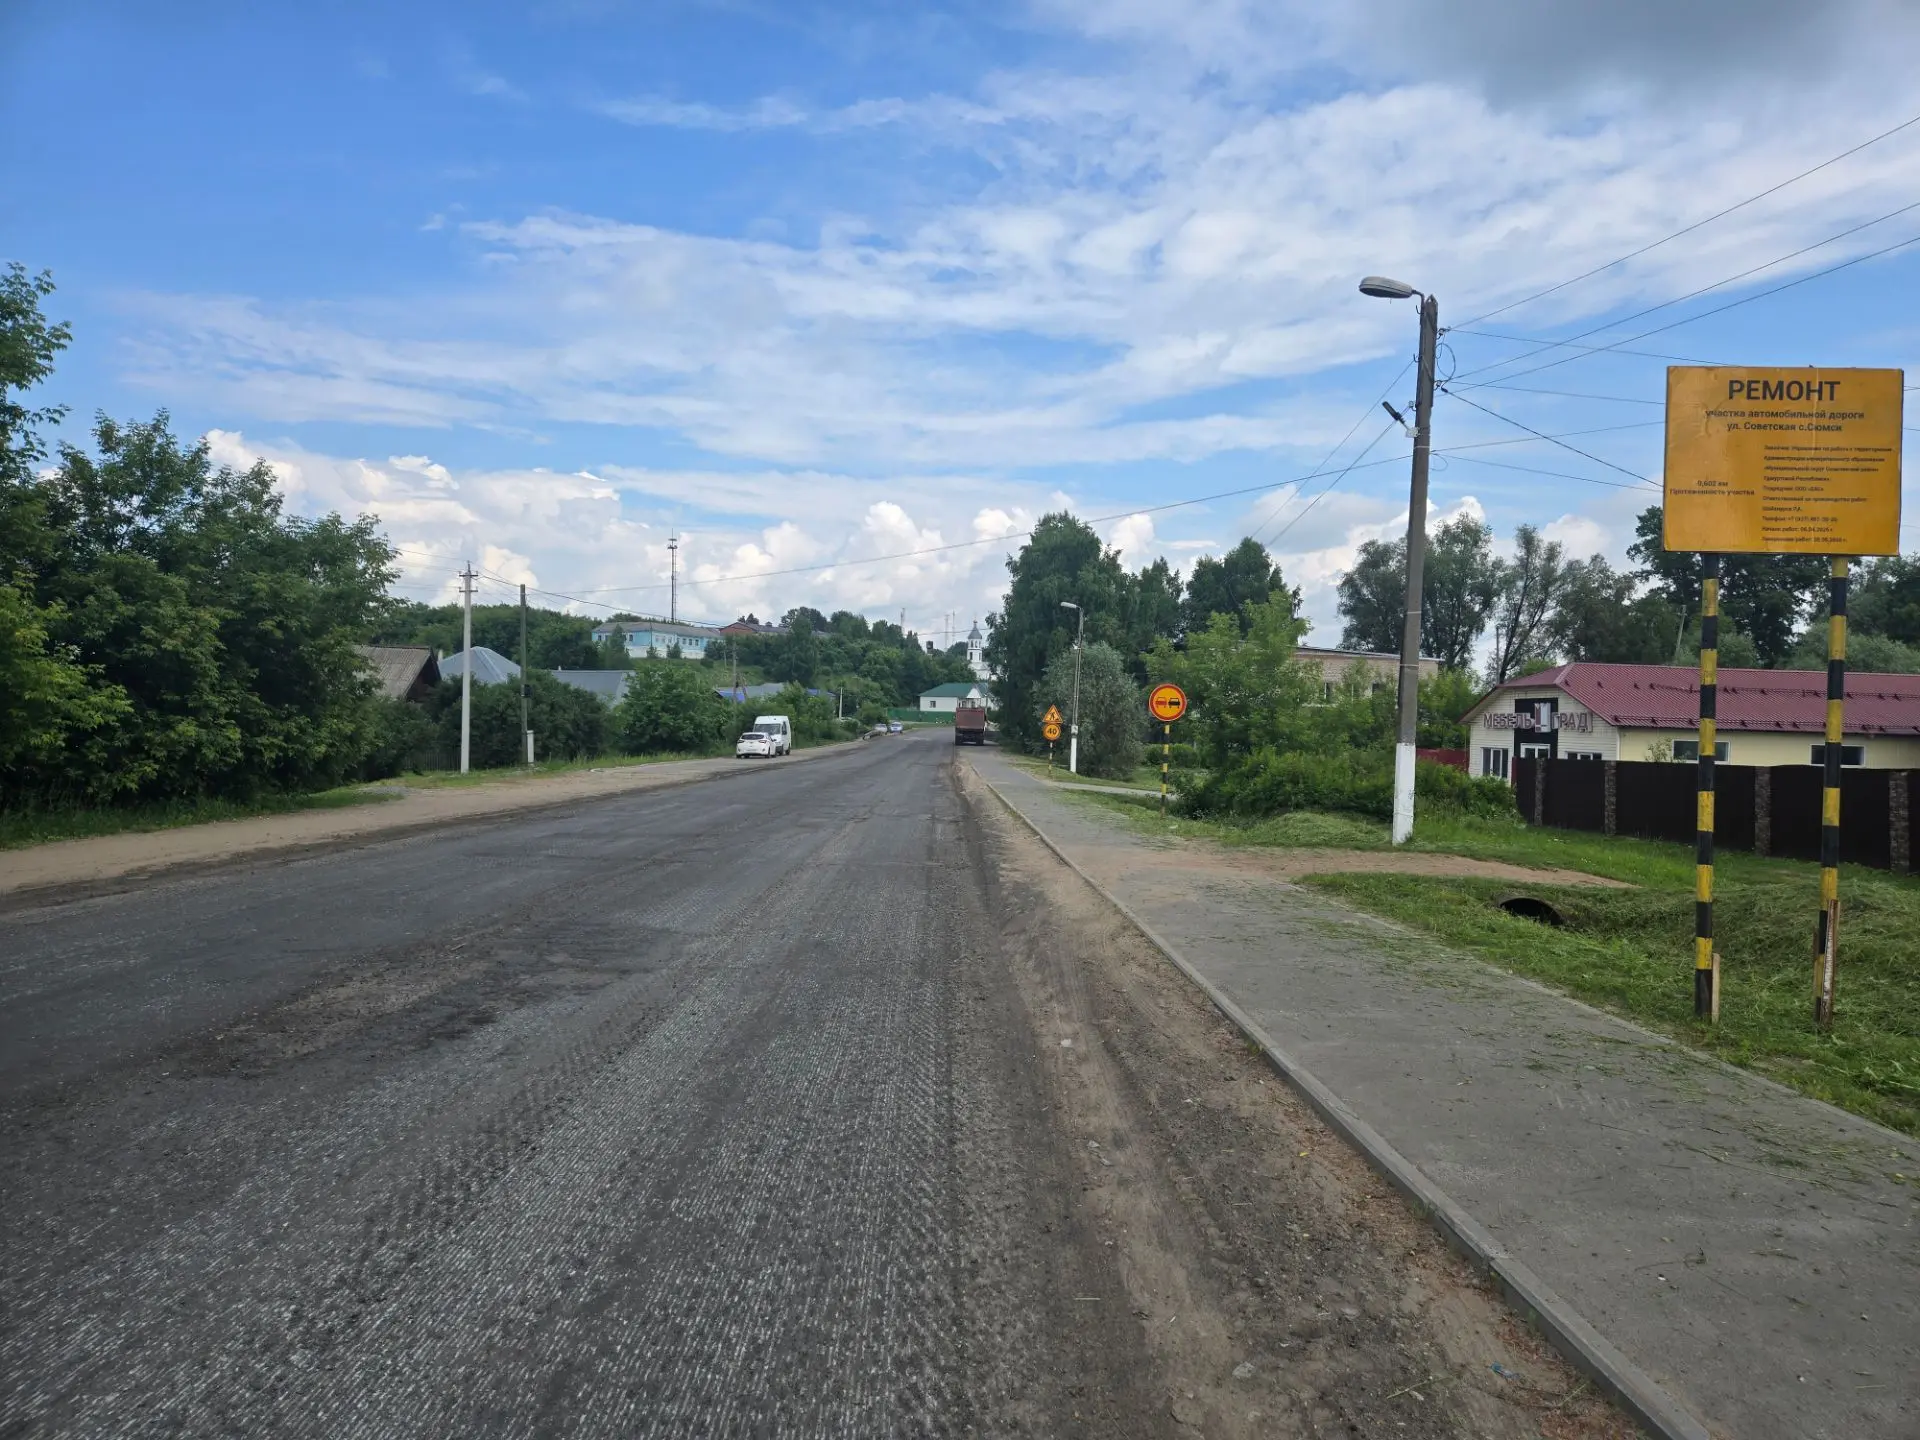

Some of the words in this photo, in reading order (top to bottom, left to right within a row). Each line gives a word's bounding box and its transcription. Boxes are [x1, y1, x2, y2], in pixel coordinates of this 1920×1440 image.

[1728, 379, 1841, 401] РЕМОНТ
[1705, 409, 1746, 419] участка
[1748, 409, 1827, 419] автомобильной
[1829, 411, 1865, 421] дороги
[1726, 422, 1741, 432] ул.
[1743, 421, 1796, 431] Советская
[1483, 712, 1533, 730] МЕБЕЛЬ
[1551, 711, 1593, 733] ГРАД
[1046, 727, 1058, 735] 40
